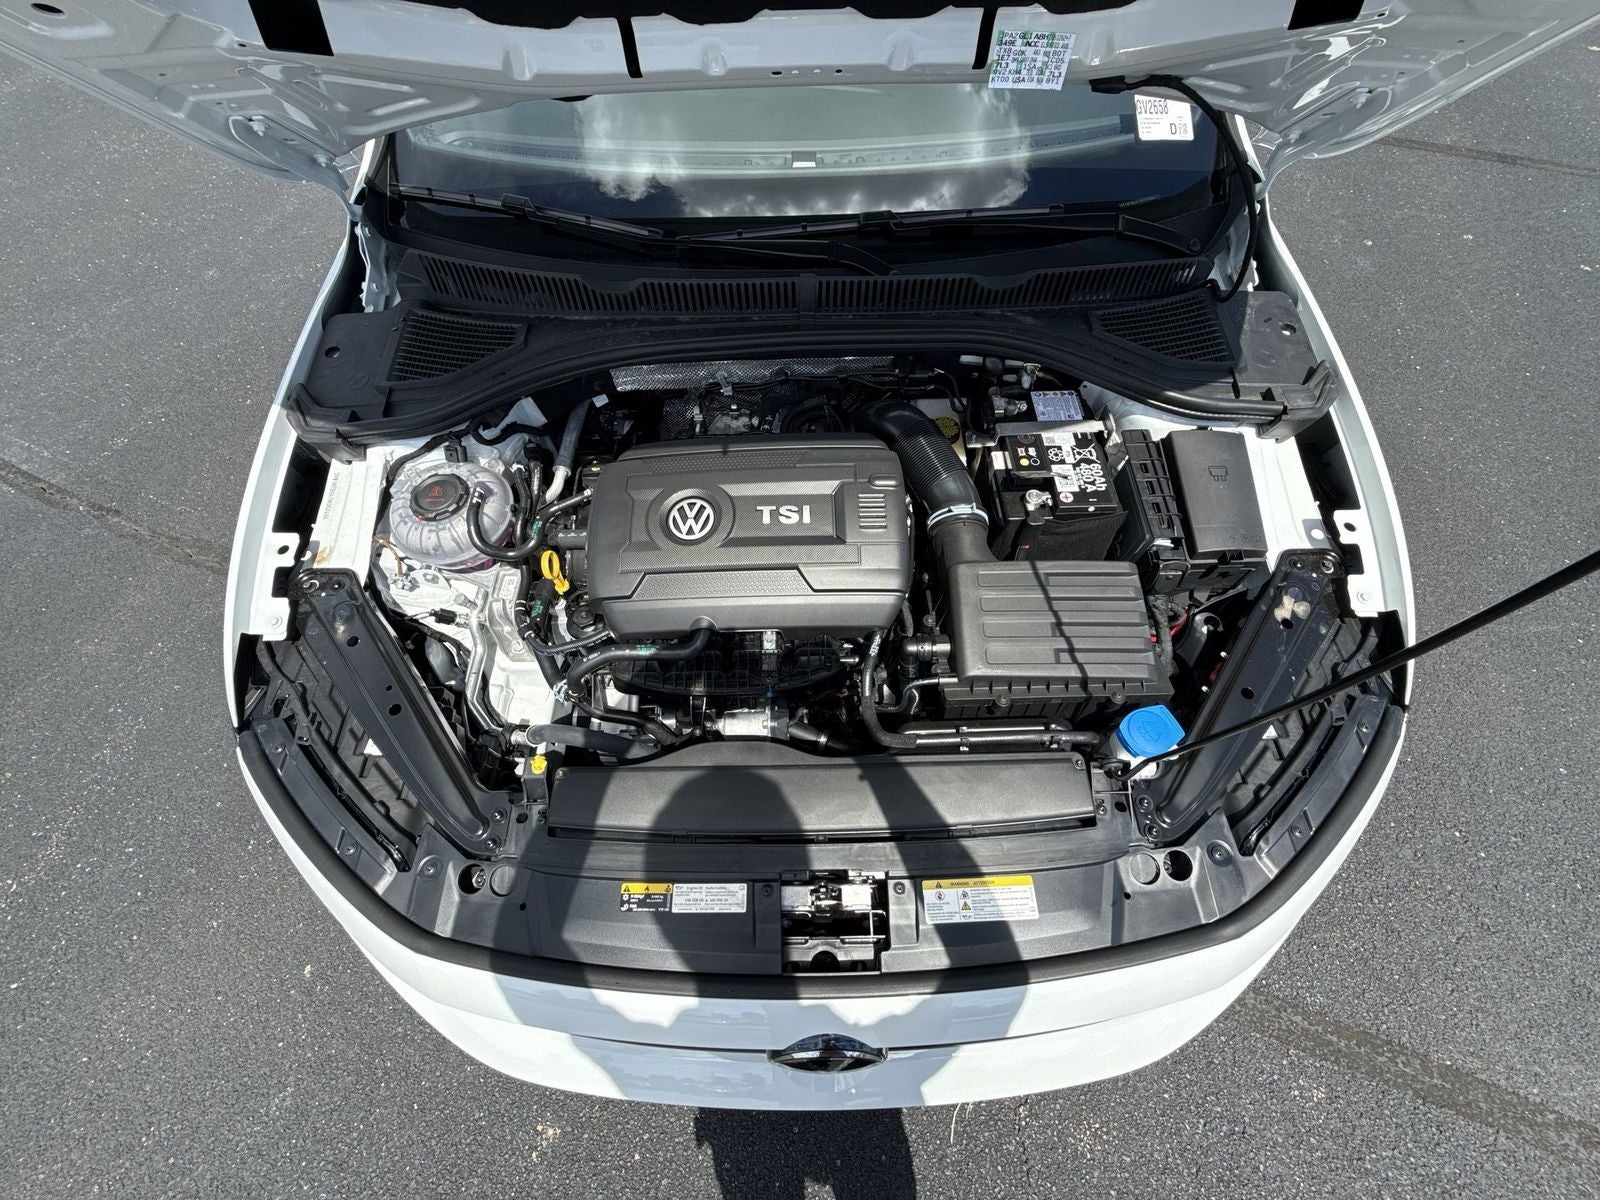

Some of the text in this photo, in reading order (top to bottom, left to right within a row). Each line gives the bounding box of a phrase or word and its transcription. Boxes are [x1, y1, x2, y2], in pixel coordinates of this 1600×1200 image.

[1080, 463, 1097, 492] 480 A
[1090, 463, 1107, 491] 60Ah
[669, 498, 715, 541] VW
[756, 504, 811, 525] TSI
